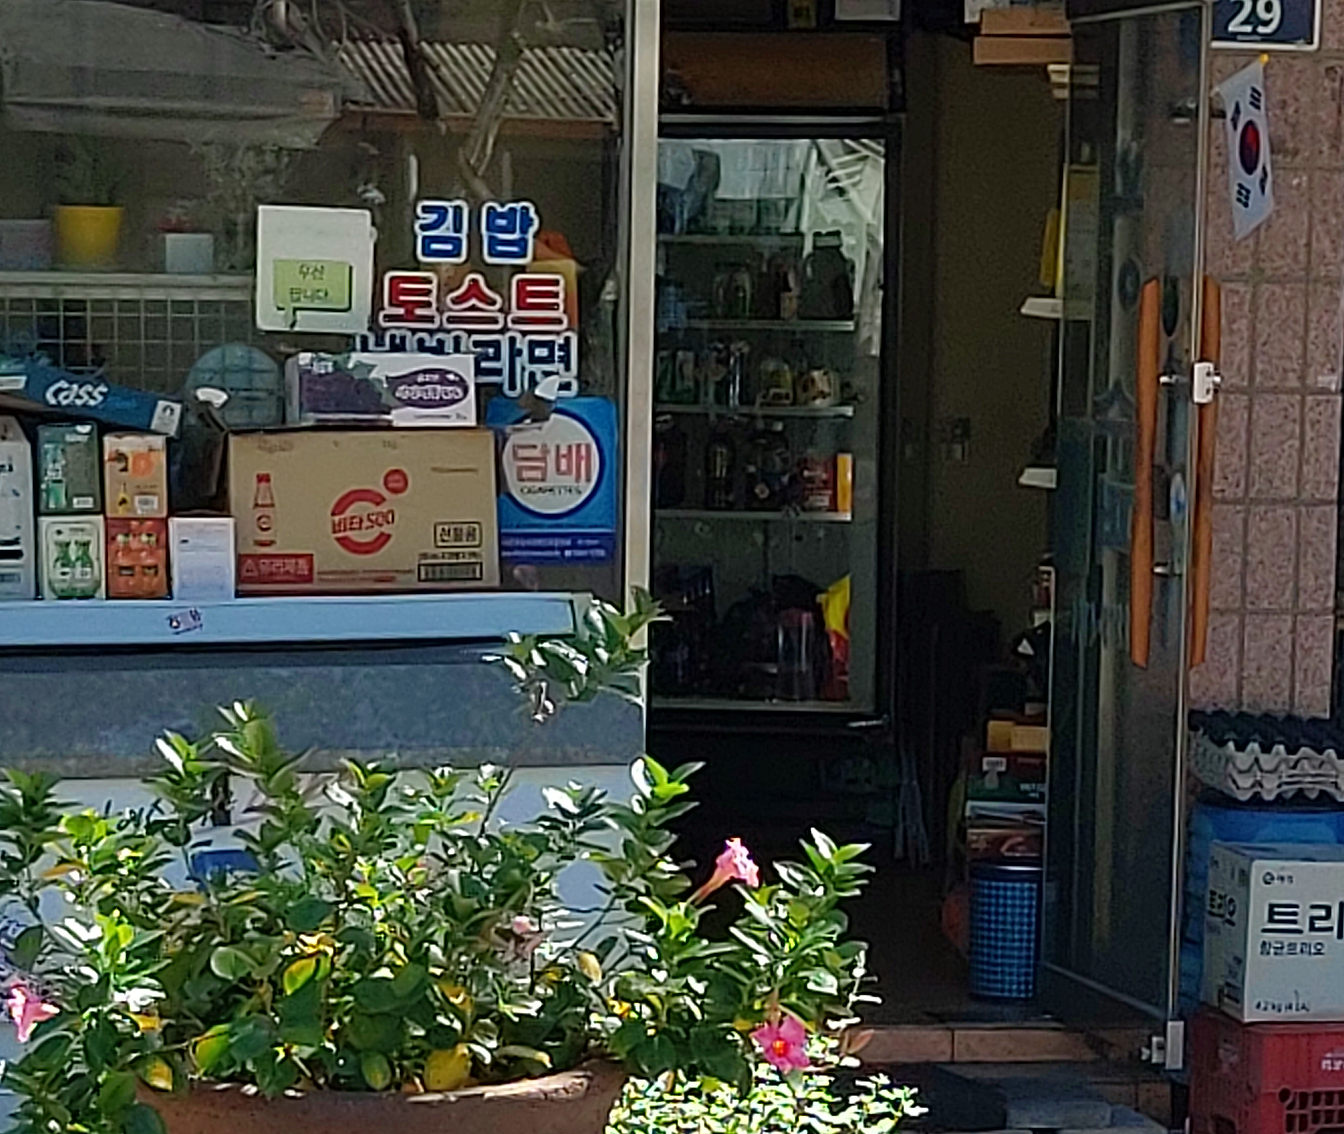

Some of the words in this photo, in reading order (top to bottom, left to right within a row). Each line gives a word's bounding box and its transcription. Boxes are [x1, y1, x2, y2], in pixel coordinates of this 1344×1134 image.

[1227, 0, 1283, 34] 29
[379, 271, 569, 331] 토스트
[45, 379, 109, 407] Cass
[512, 442, 592, 483] 담배
[330, 508, 396, 535] 비타500
